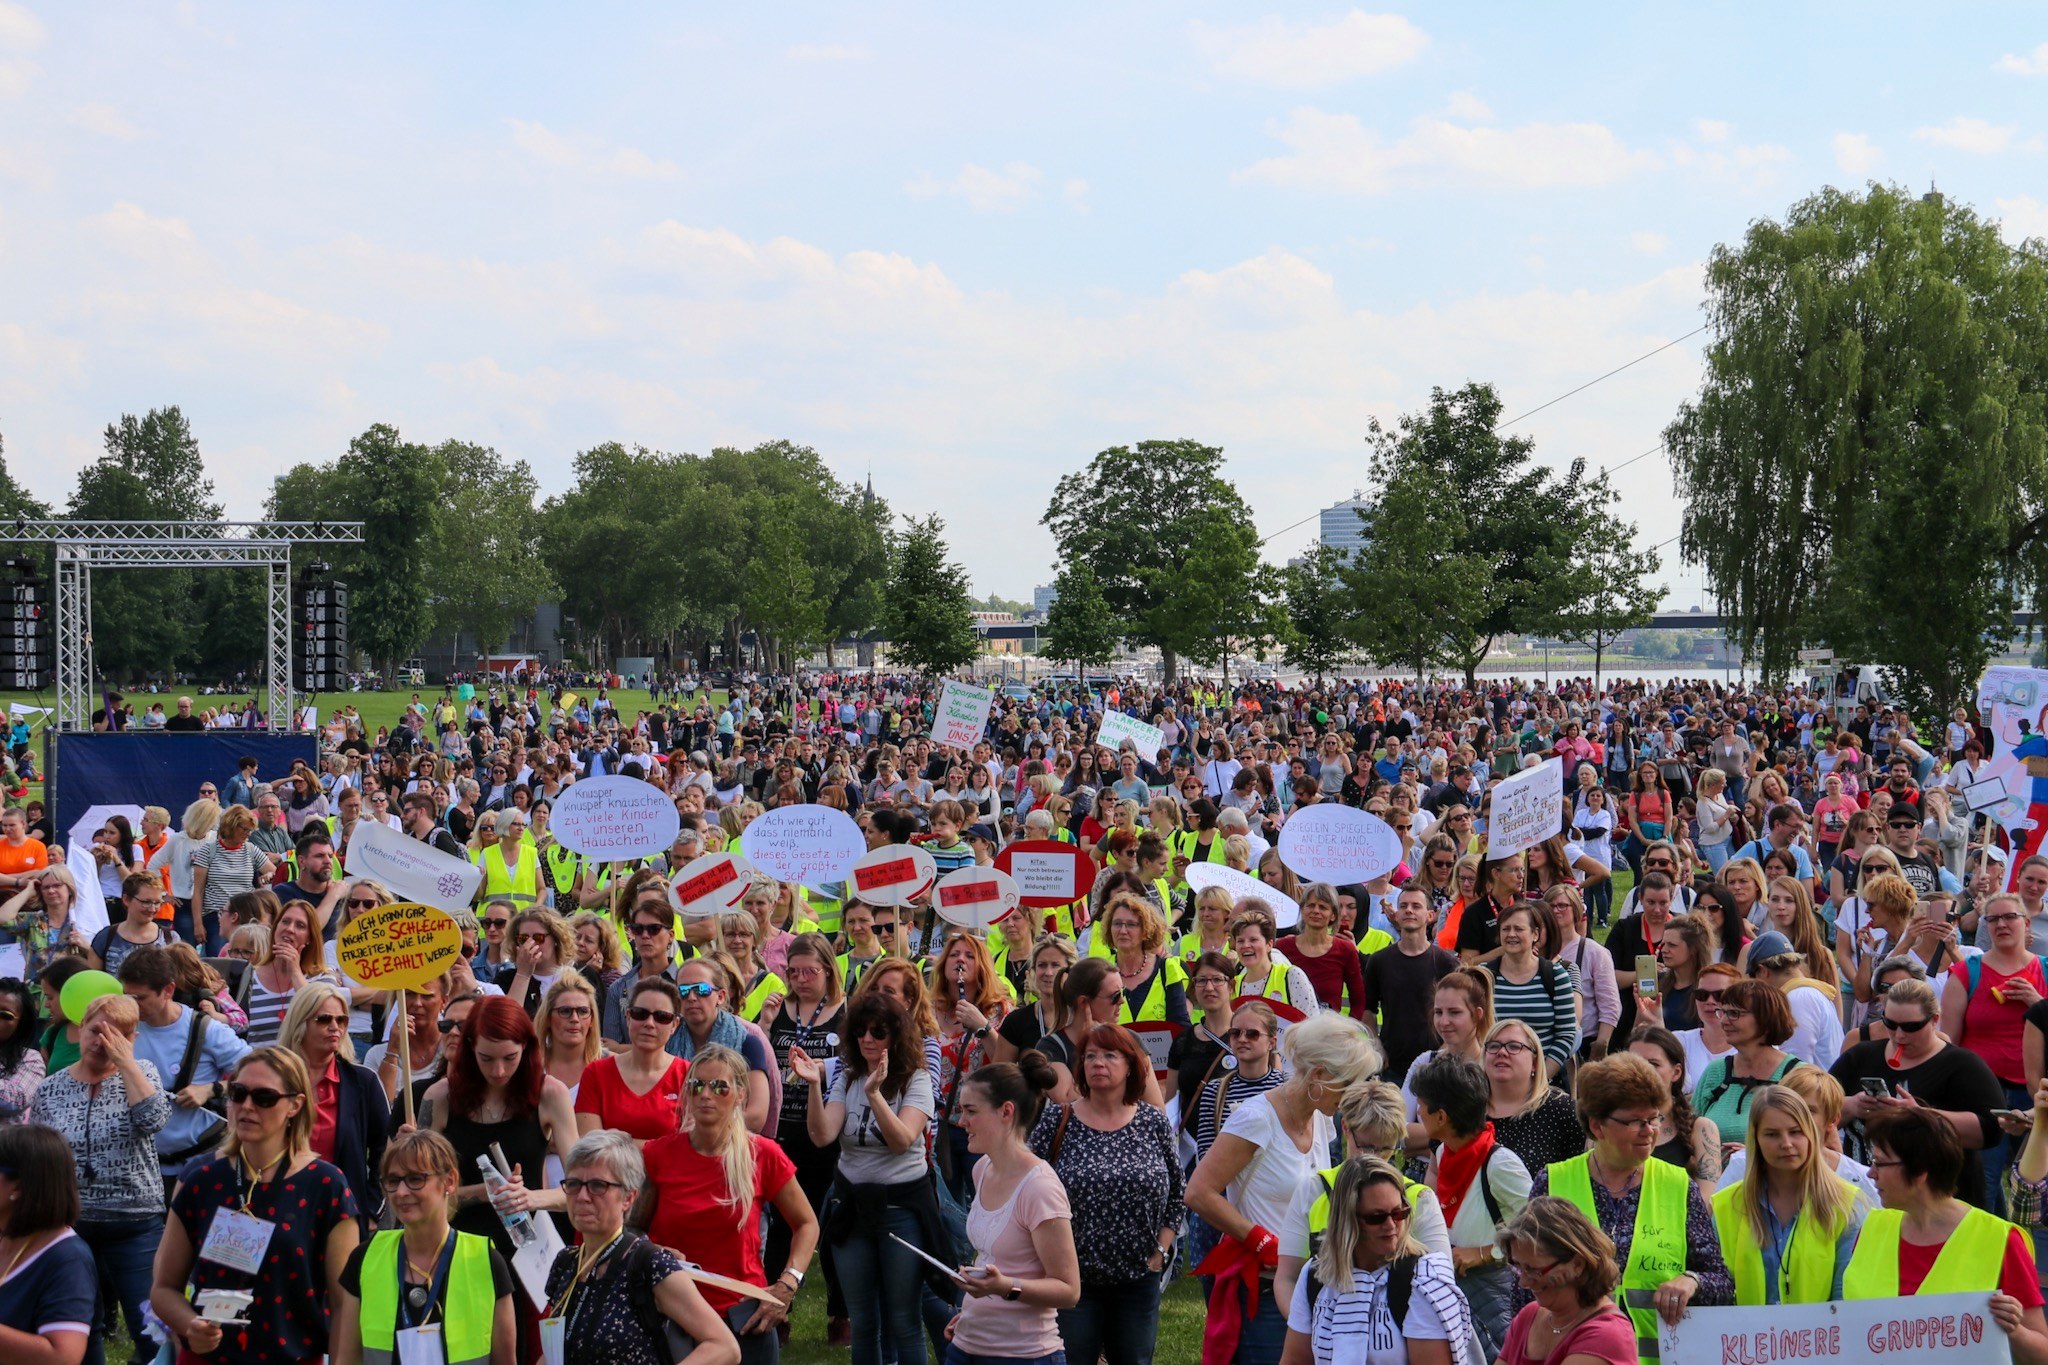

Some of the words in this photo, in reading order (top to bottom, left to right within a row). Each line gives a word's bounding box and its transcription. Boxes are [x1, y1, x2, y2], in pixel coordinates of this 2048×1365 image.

[948, 730, 979, 744] UNS!
[575, 788, 613, 801] Knusper
[564, 800, 602, 814] Knusper
[564, 817, 579, 826] zu
[586, 811, 614, 824] viele
[621, 809, 660, 820] Kinder
[764, 815, 784, 826] Ach
[788, 816, 804, 826] wie
[808, 814, 826, 830] gut
[574, 828, 583, 837] in
[593, 822, 644, 835] unseren
[754, 827, 778, 838] dass
[784, 826, 832, 838] niemand
[1288, 822, 1329, 833] SPIEGLEIN
[1335, 823, 1386, 834] SPIEGLEIN
[1302, 834, 1312, 844] AN
[1318, 835, 1337, 845] DER
[364, 842, 411, 870] kirchenkreis
[753, 848, 787, 860] dieses
[792, 848, 830, 860] Gesetz
[836, 848, 852, 858] ist
[1294, 844, 1321, 856] KEINE
[1328, 845, 1375, 858] BILDUNG
[396, 849, 441, 873] evangelischer
[776, 861, 792, 870] der
[1298, 858, 1306, 866] IN
[1312, 857, 1346, 868] DIESEM
[358, 916, 376, 932] ICH
[405, 907, 426, 919] GAR
[372, 928, 386, 940] SO
[388, 919, 454, 940] SCHLECHT
[354, 952, 425, 981] BEZAHLT
[424, 944, 456, 964] WERDE
[1642, 1224, 1664, 1240] für
[1658, 1240, 1672, 1250] die
[1867, 1312, 1984, 1354] GRUPPEN
